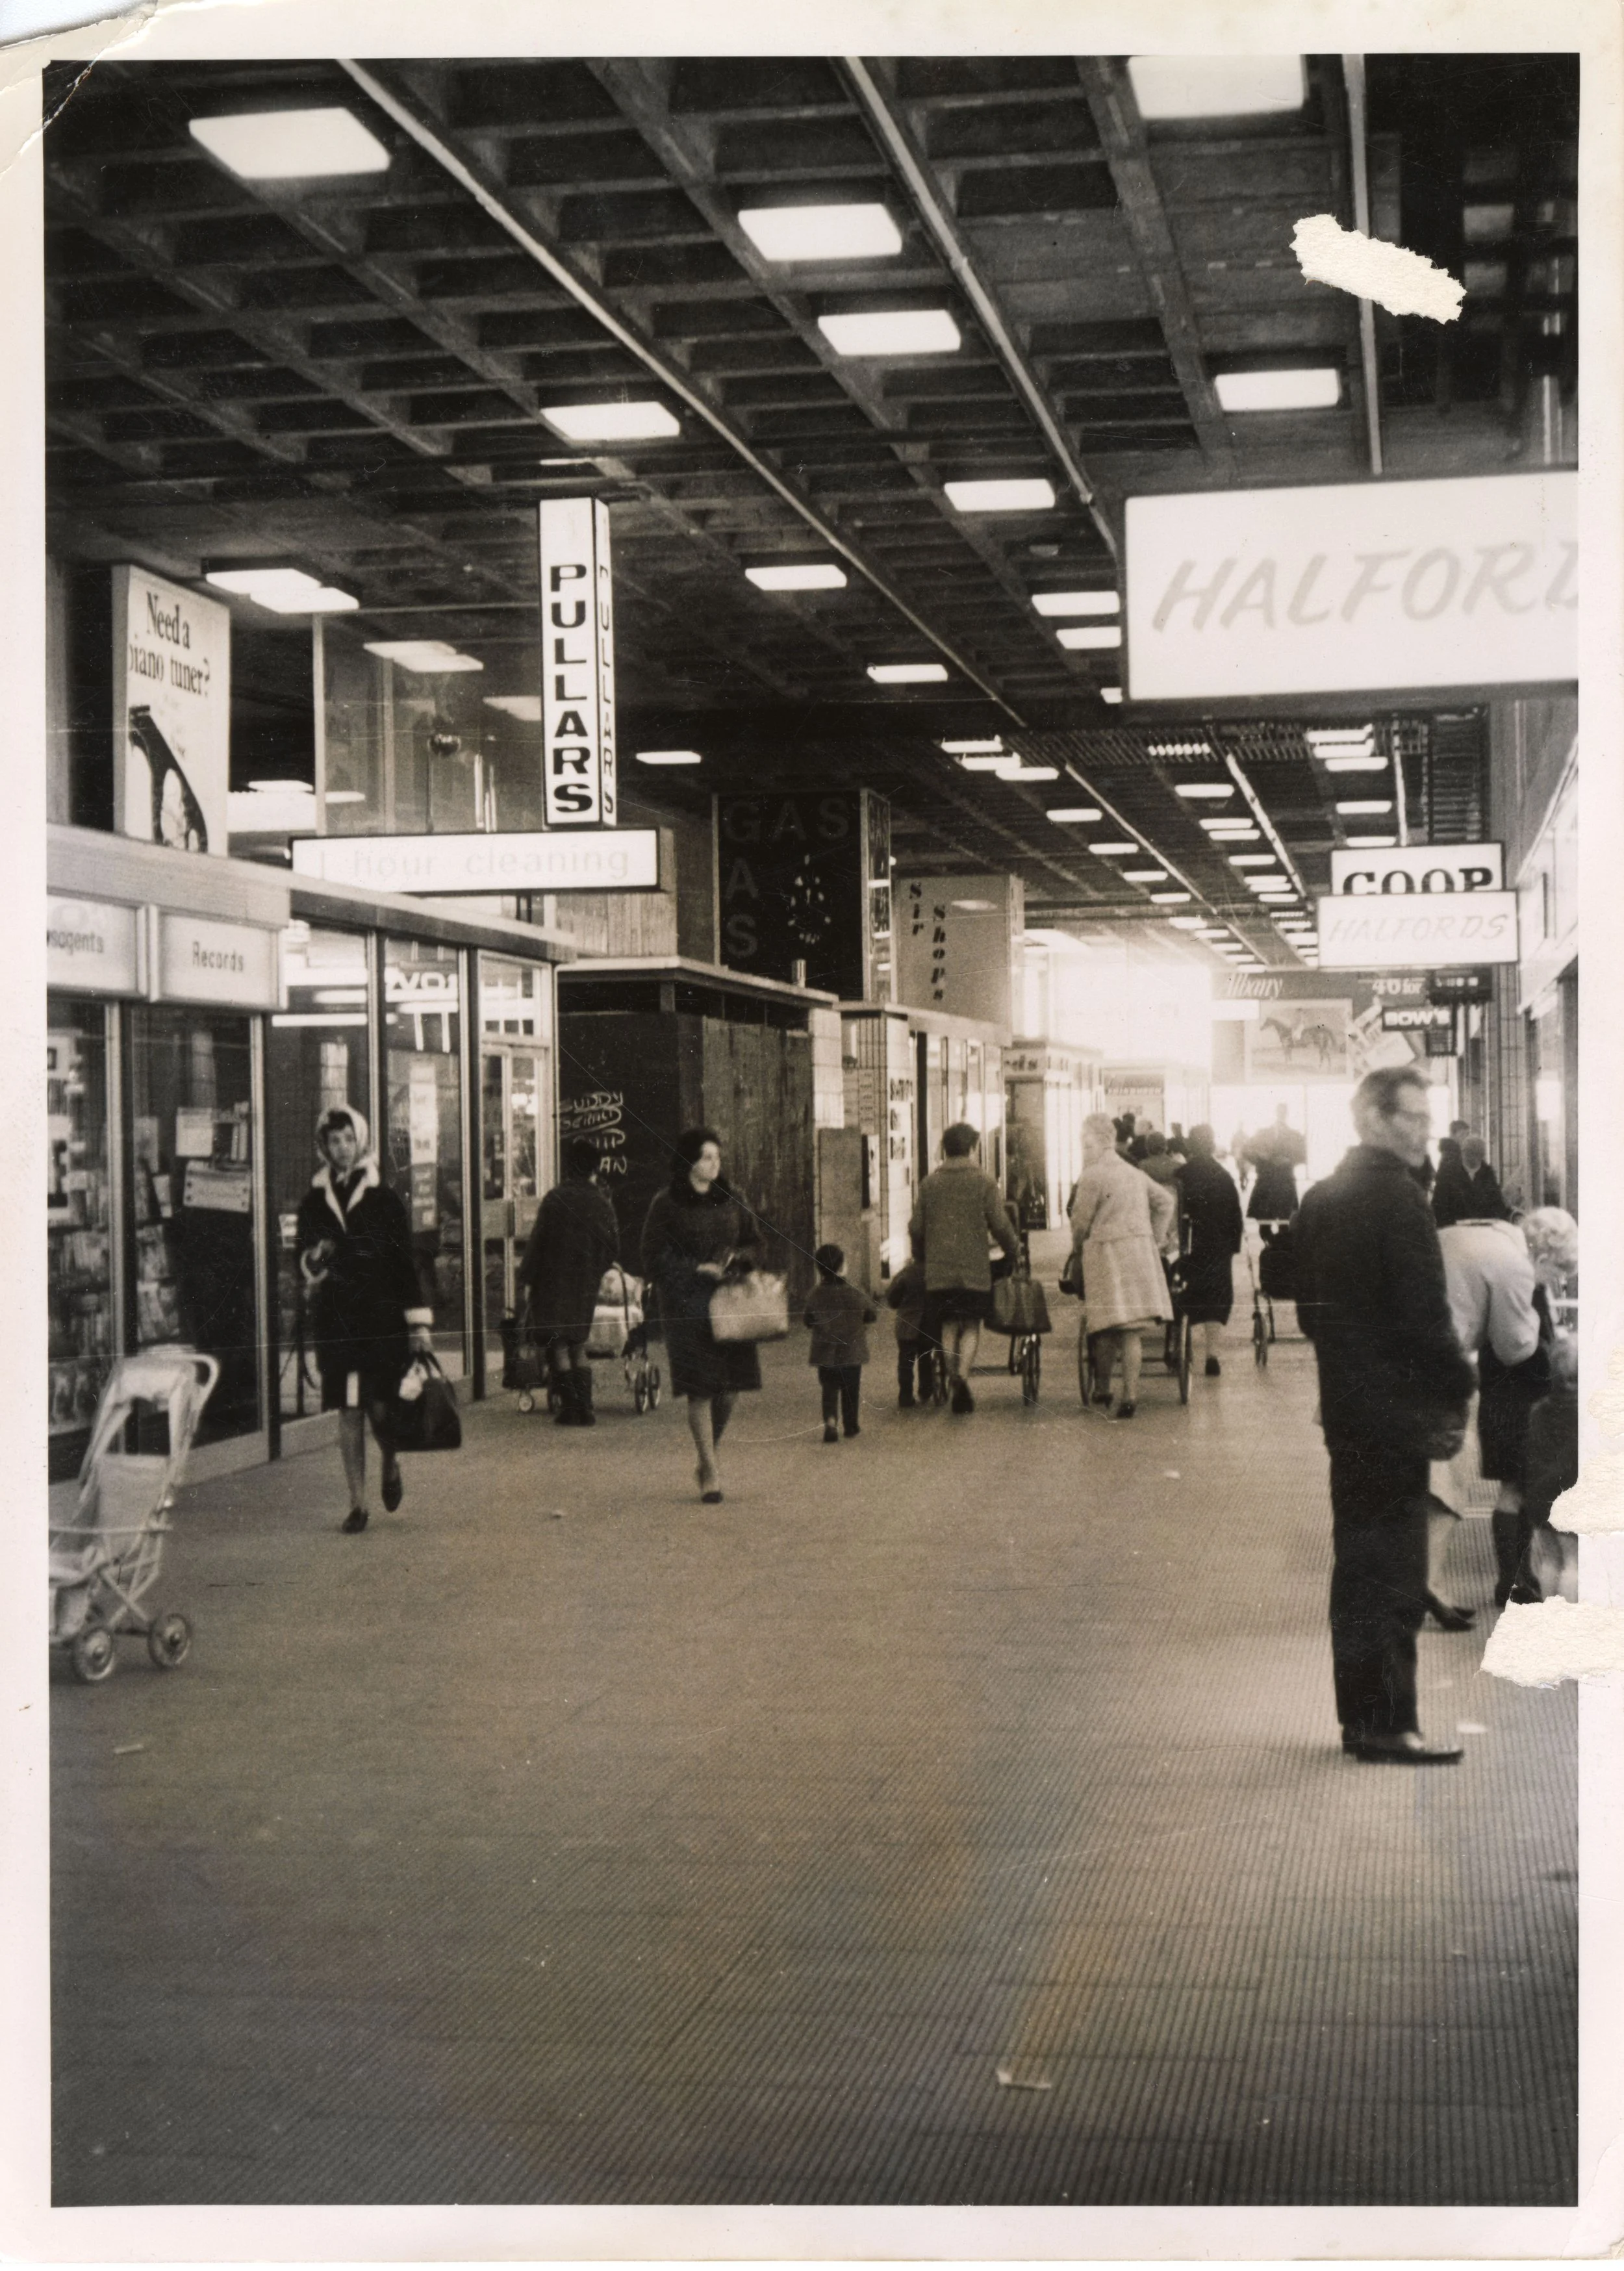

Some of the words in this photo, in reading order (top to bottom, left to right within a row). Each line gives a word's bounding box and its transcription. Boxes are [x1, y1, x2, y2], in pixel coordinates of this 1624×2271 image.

[147, 590, 180, 645] Need
[183, 620, 190, 650] a
[170, 655, 210, 698] tuner?
[550, 563, 592, 813] PULLARS
[724, 798, 850, 843] GAS
[354, 848, 434, 878] hour
[465, 845, 629, 880] cleaning
[1328, 913, 1510, 942] HALFORDS
[192, 940, 244, 972] Records
